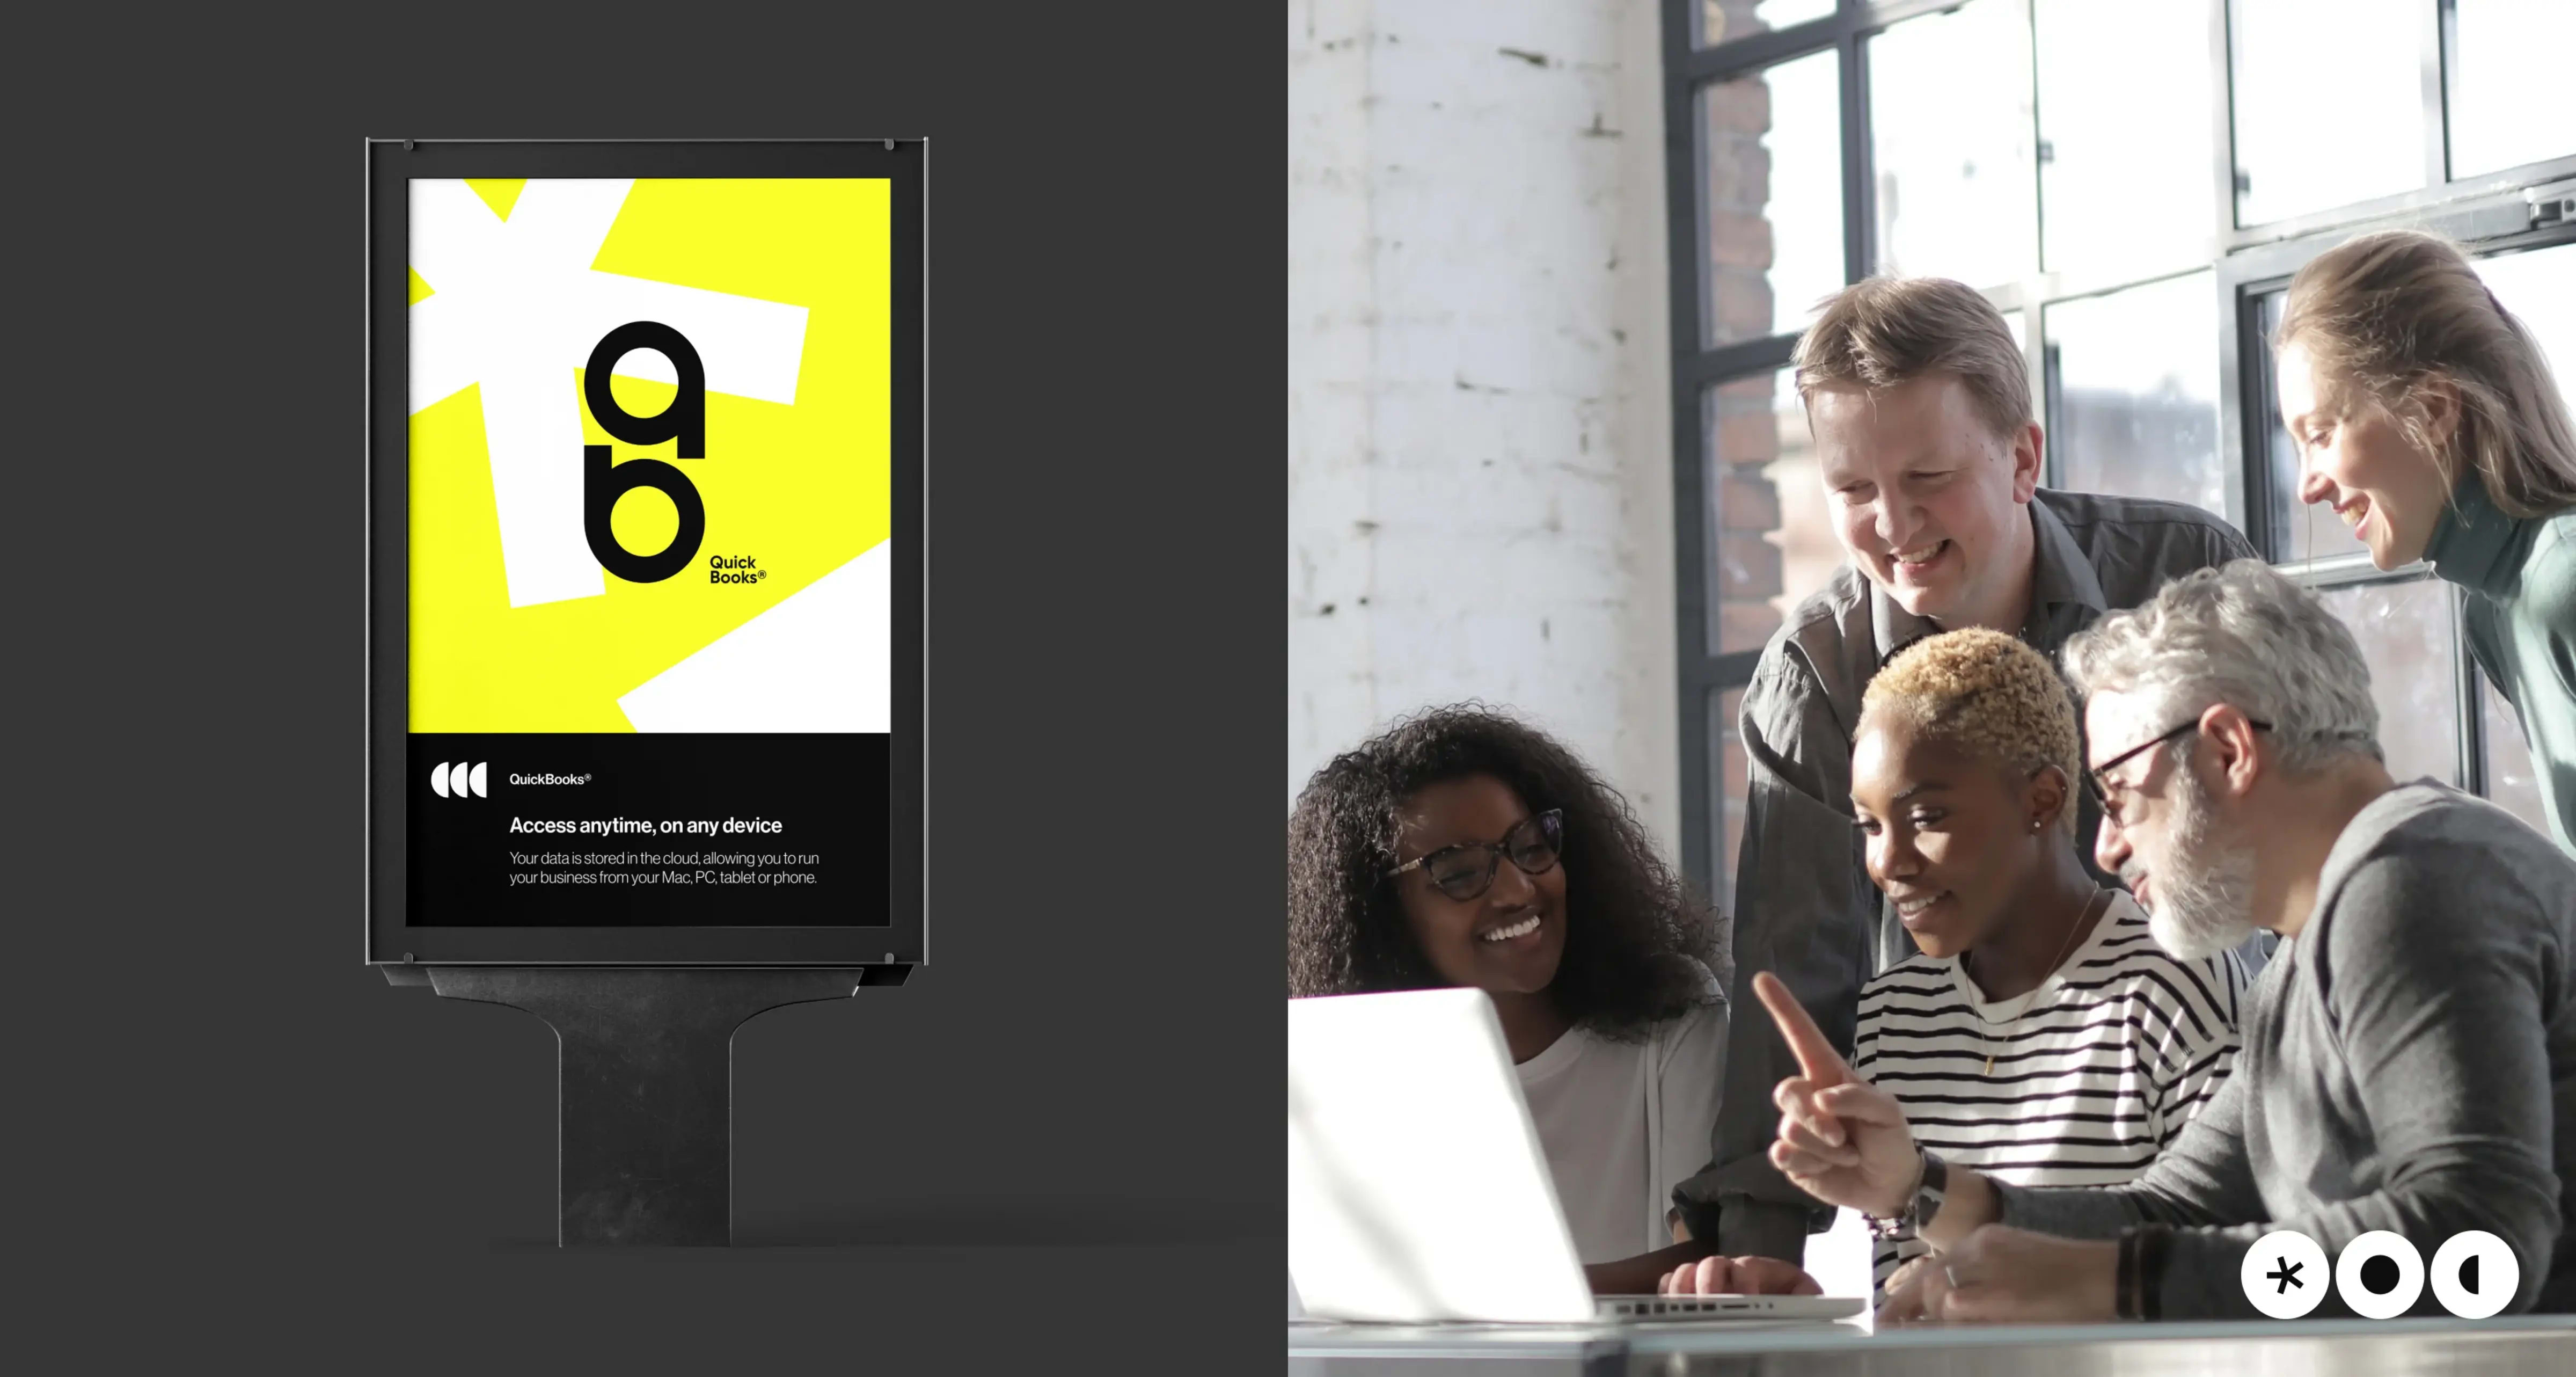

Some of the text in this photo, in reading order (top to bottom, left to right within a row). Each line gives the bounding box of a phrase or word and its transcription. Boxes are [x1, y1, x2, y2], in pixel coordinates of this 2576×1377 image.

[709, 555, 757, 569] Quick
[509, 817, 783, 837] Access anytime, on any device
[509, 851, 819, 868] Your data is stored in the cloud, allowing you to run
[509, 870, 817, 886] your business from your Mac, PC, tablet or phone.
